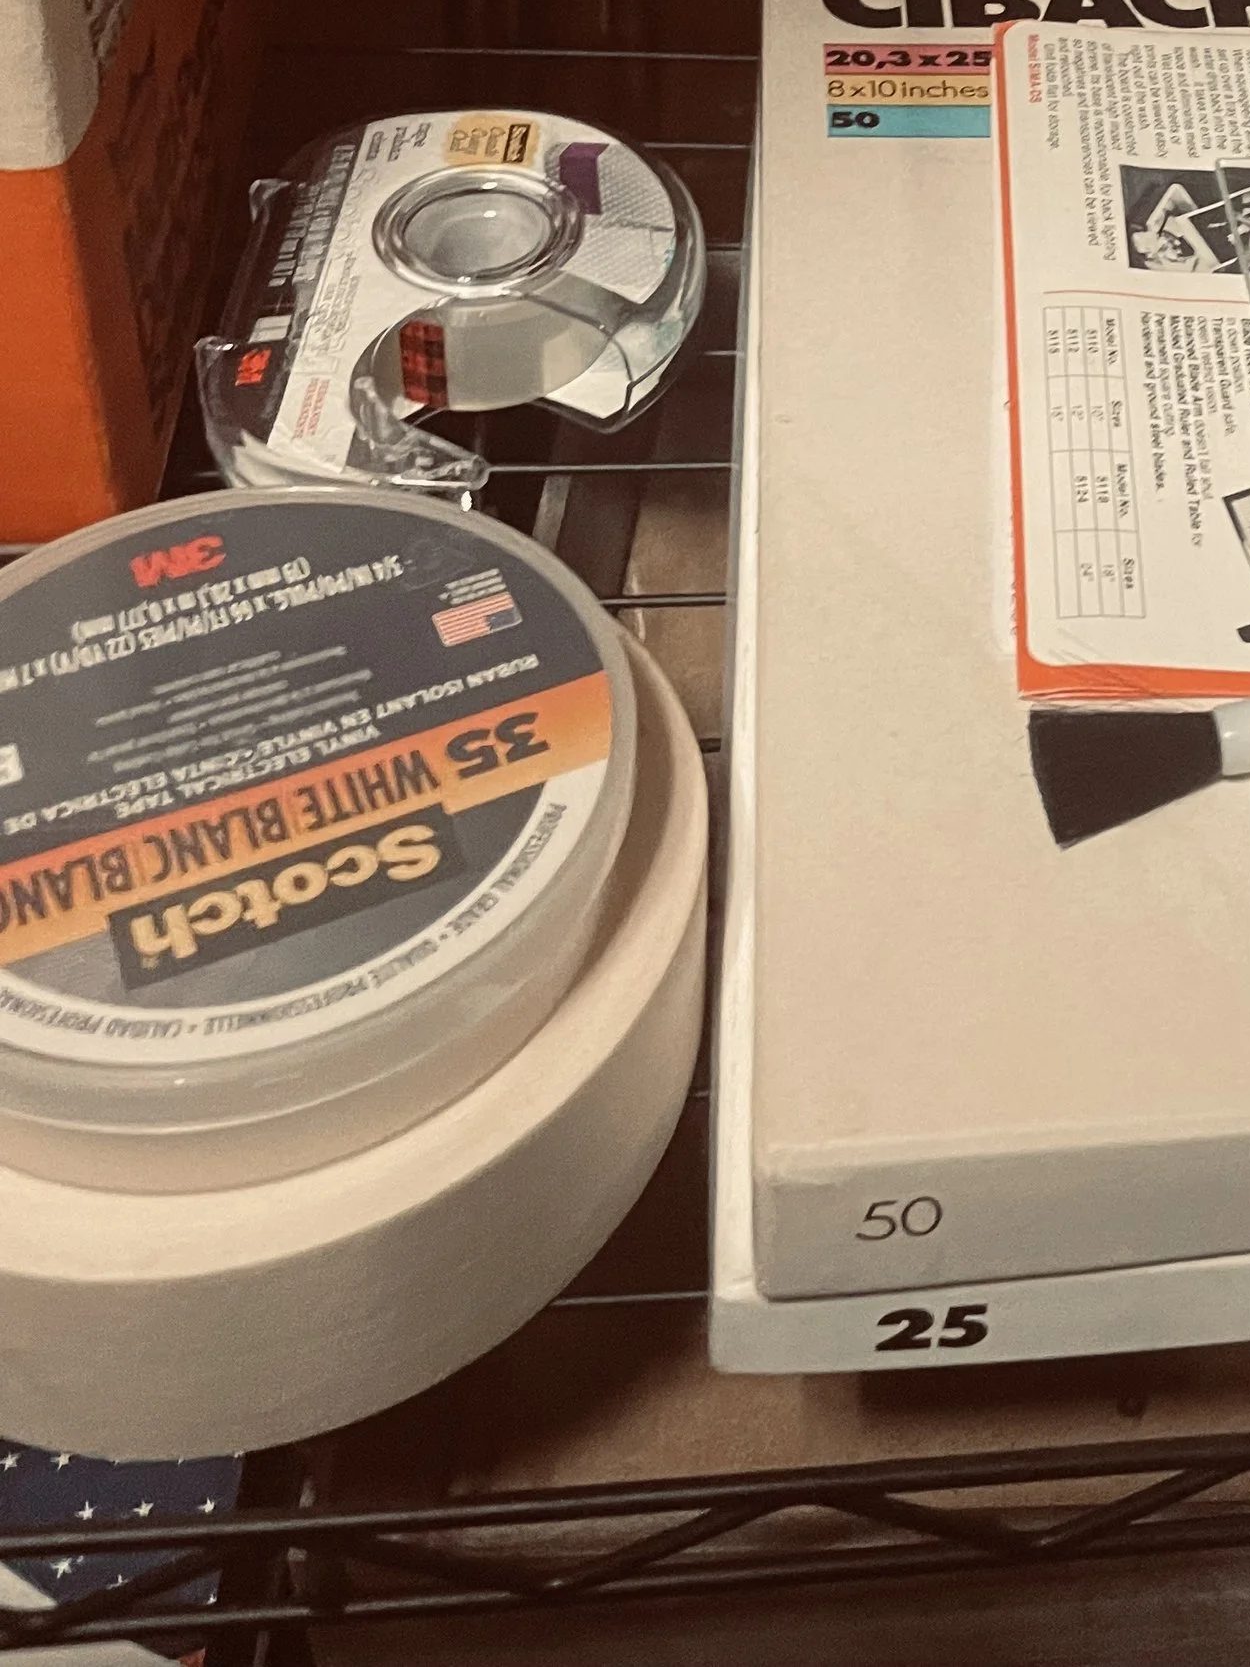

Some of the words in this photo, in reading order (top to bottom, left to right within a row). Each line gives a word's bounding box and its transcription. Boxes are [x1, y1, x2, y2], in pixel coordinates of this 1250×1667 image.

[902, 80, 989, 98] inches
[831, 111, 880, 128] 50
[130, 536, 226, 588] 3M
[445, 711, 550, 781] 35
[113, 789, 174, 819] TAPE
[294, 749, 438, 832] WHITE
[141, 797, 291, 885] BLANC
[128, 823, 443, 960] Scotch
[855, 1195, 943, 1242] 50
[874, 1303, 988, 1352] 25
